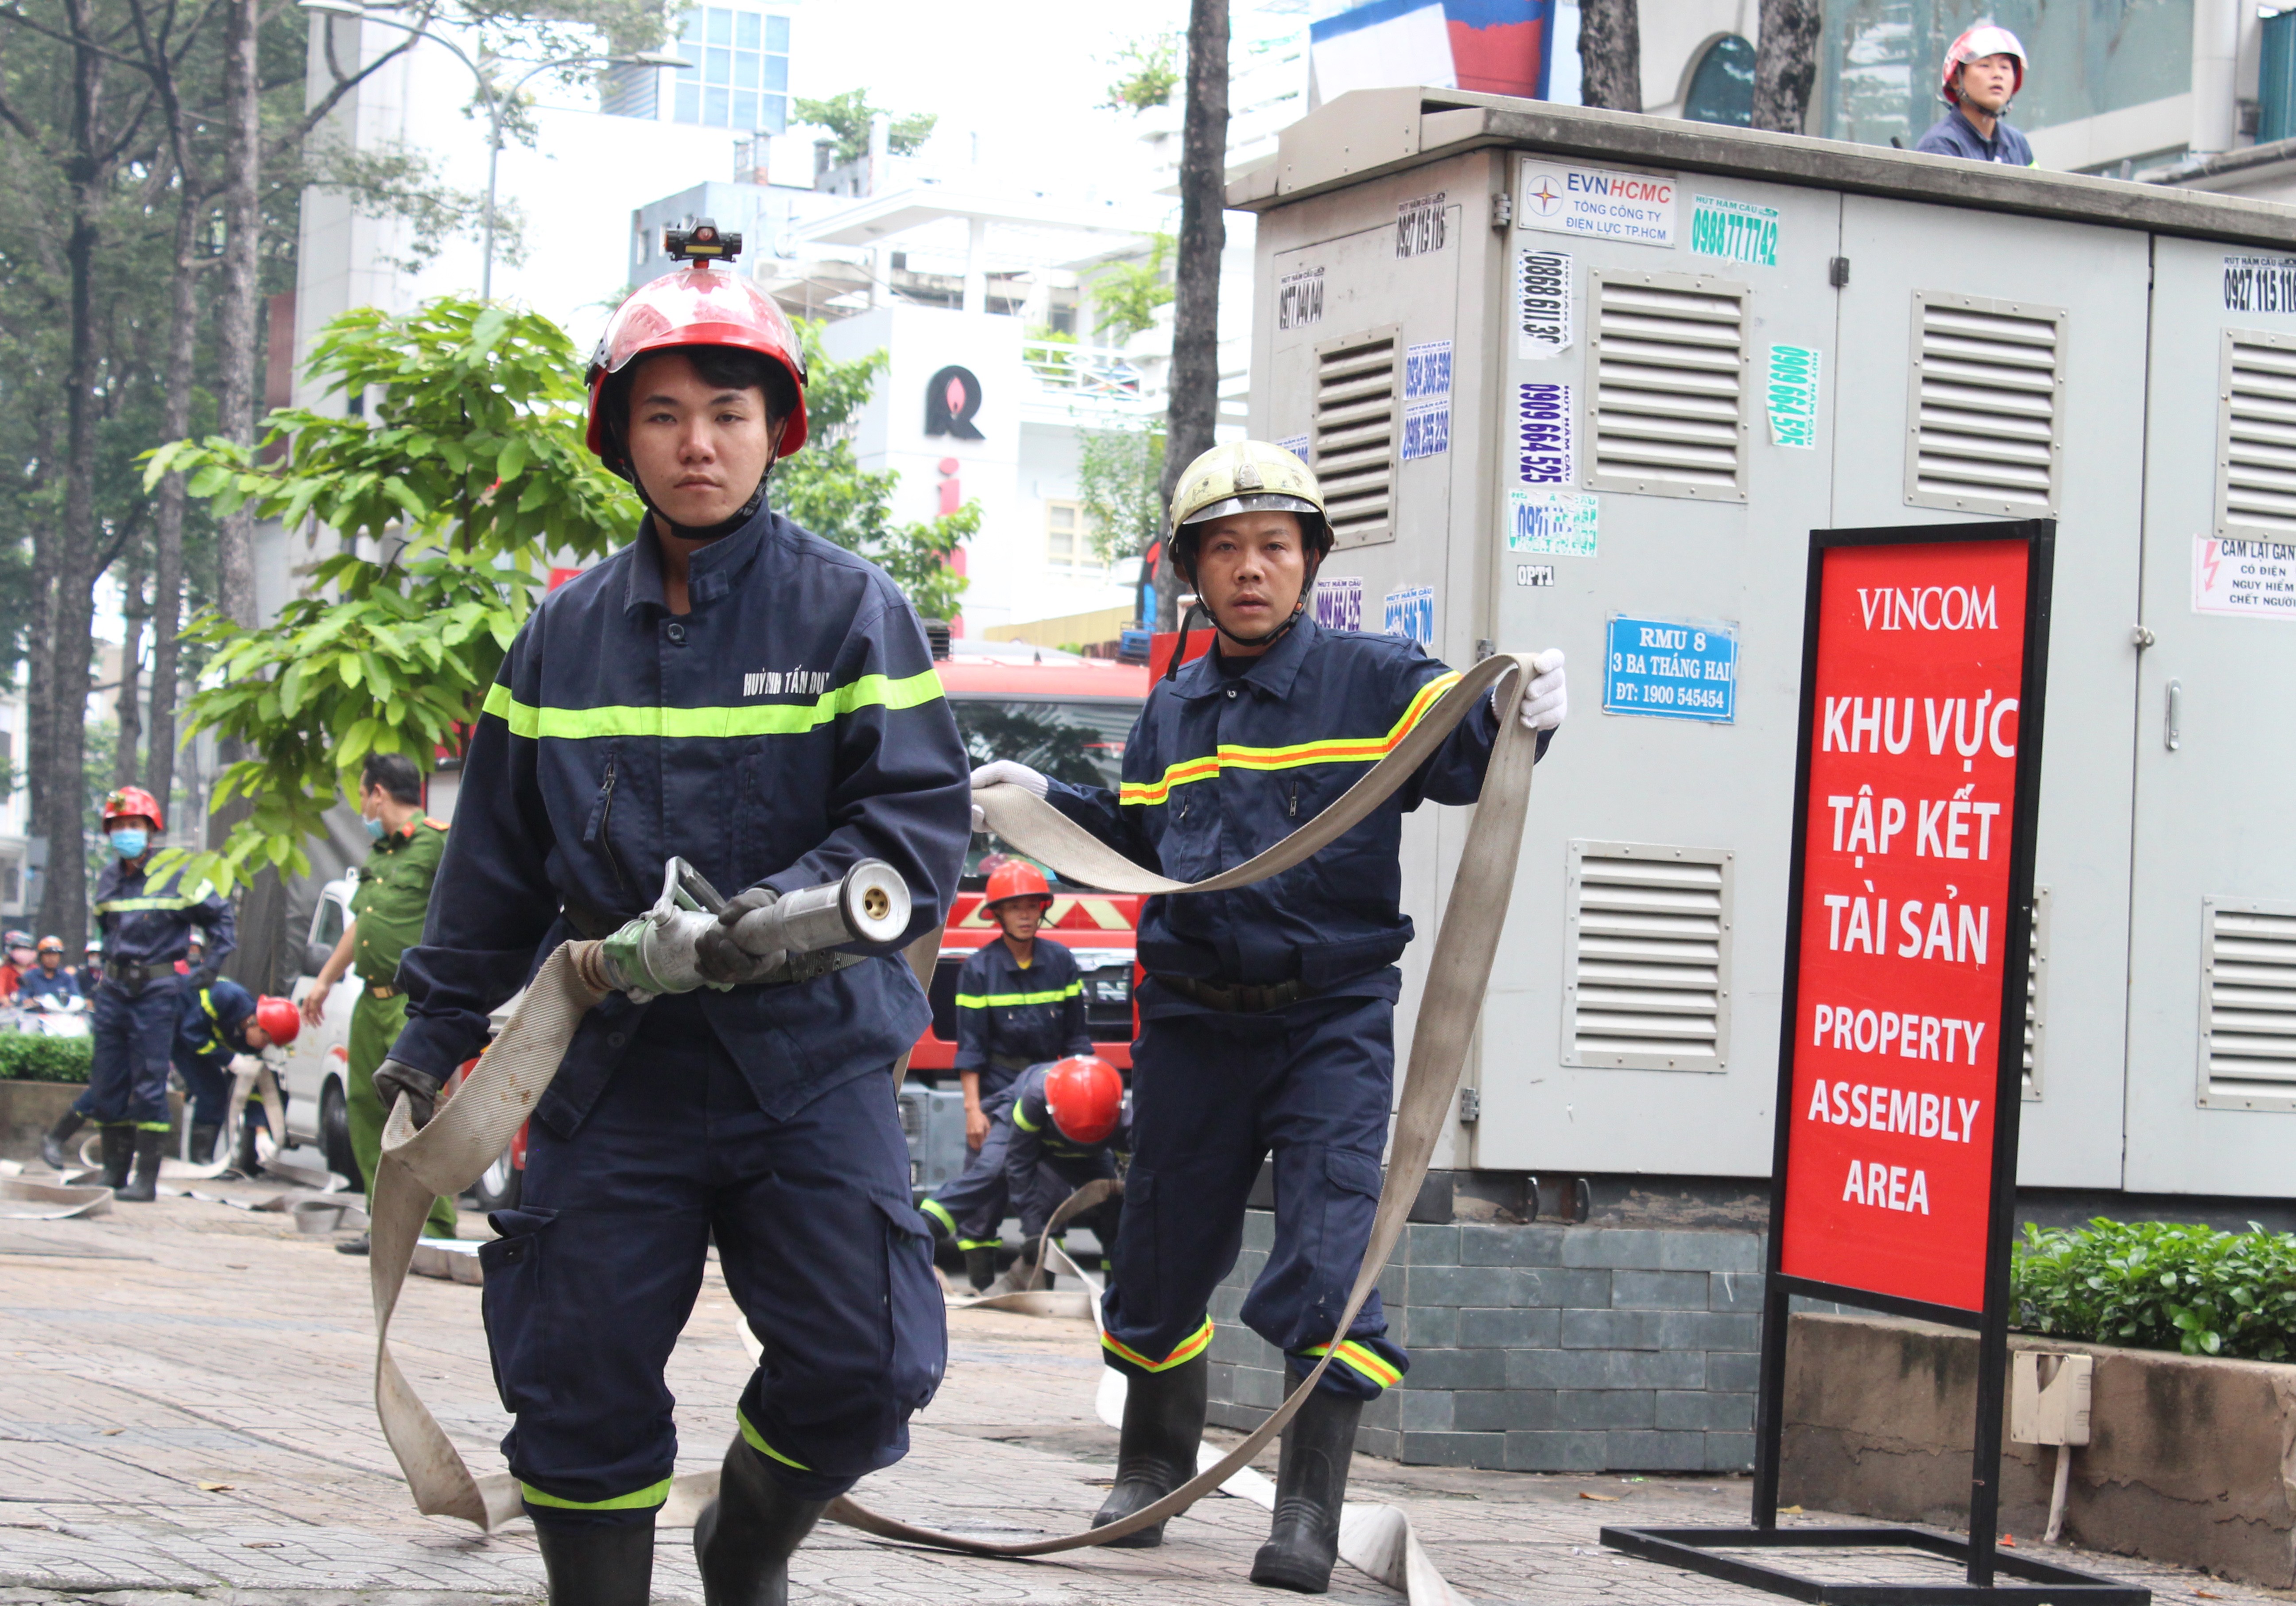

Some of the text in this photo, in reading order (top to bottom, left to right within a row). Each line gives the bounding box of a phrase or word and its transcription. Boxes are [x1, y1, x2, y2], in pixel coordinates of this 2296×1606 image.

[1567, 173, 1671, 203] EVNHCMC
[1566, 217, 1666, 240] ĐIỆN LỰC TP.HCM
[1610, 205, 1643, 220] CÔNG
[1647, 211, 1661, 222] TY
[1519, 384, 1562, 483] 0909.664.525
[1517, 565, 1554, 586] OPT1
[2232, 580, 2261, 590] NGUY
[1857, 585, 1998, 630] VINCOM
[1639, 627, 1706, 652] RMU 8
[784, 664, 809, 694] TẤN
[1613, 652, 1730, 681] 3 BA THÁNG HAI
[1616, 682, 1724, 708] ĐT: 1900 545454
[1822, 688, 2019, 773] KHU VỰC
[1827, 784, 2000, 868] TẬP KẾT
[1823, 880, 1989, 964] TÀI SẢN
[1813, 1004, 1986, 1065] PROPERTY
[1808, 1079, 1980, 1143] ASSEMBLY
[1842, 1160, 1929, 1215] AREA
